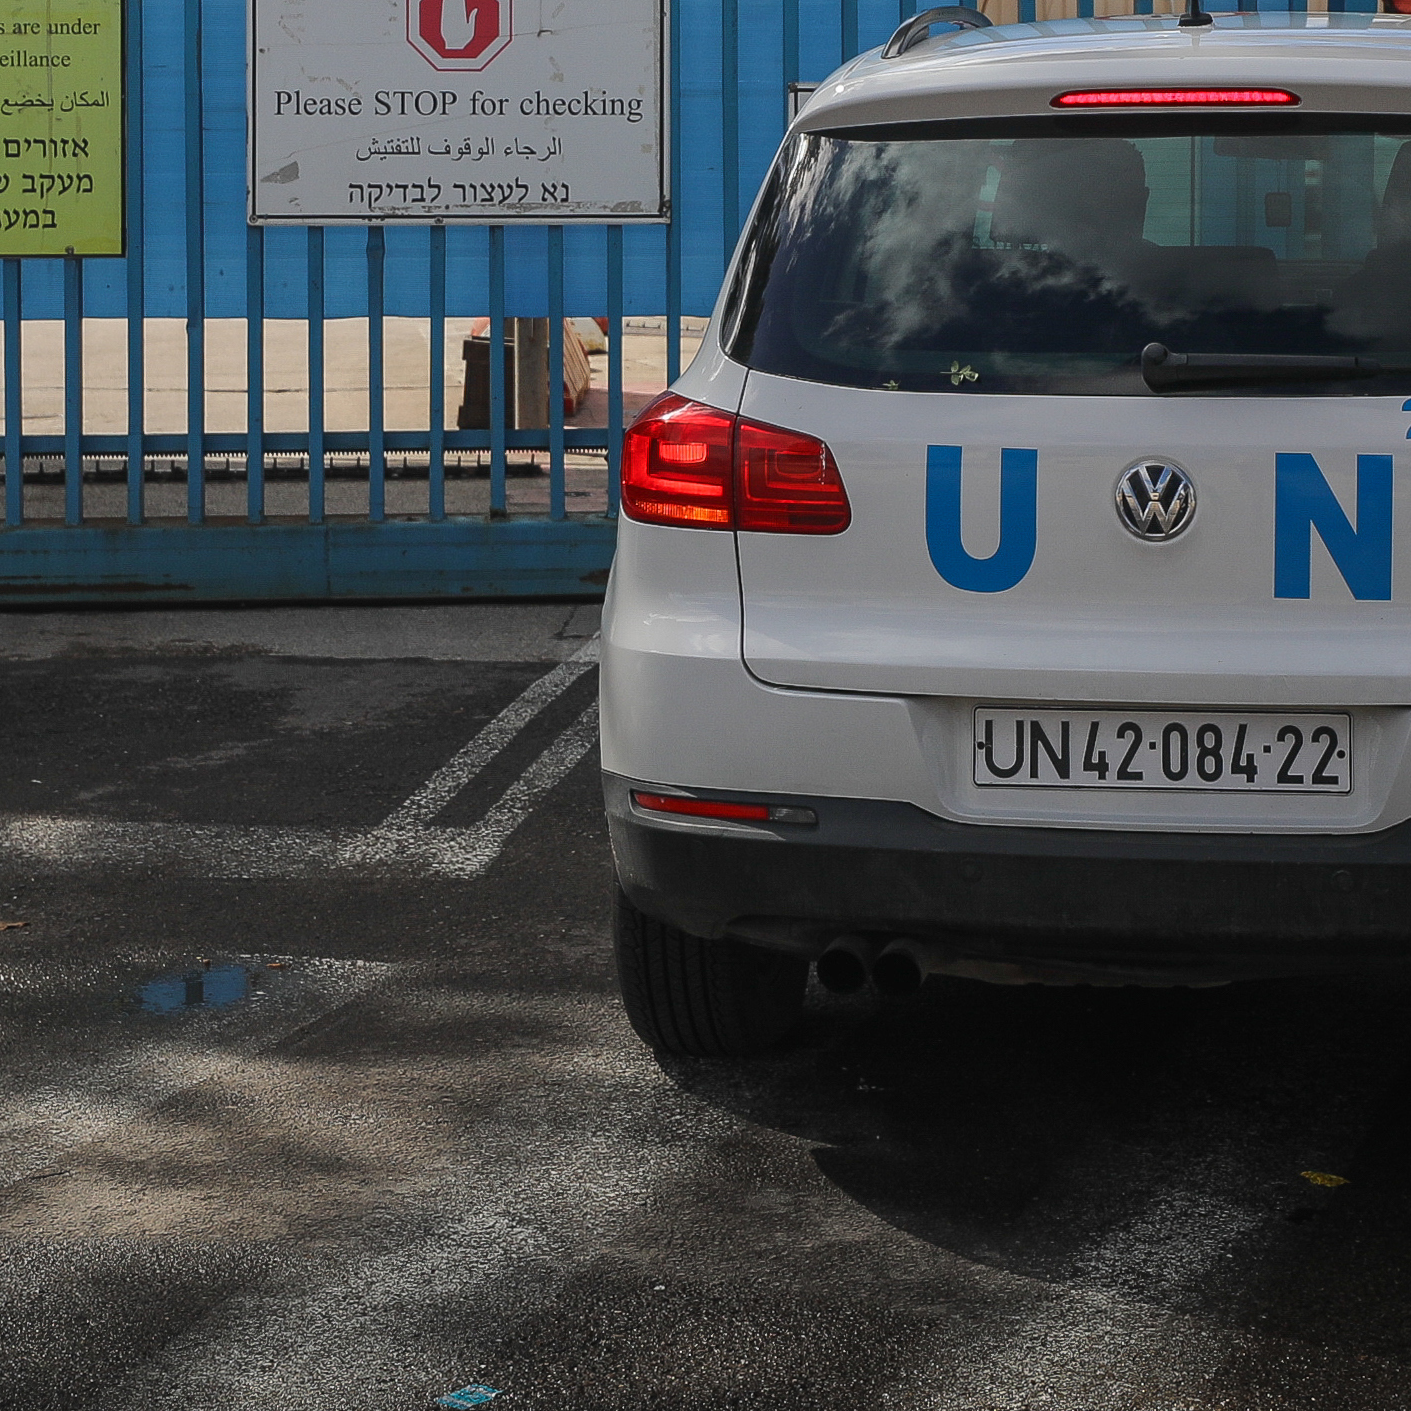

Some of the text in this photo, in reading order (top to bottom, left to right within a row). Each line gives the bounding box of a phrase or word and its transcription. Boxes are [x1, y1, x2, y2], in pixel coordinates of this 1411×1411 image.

[13, 23, 40, 34] are
[47, 18, 100, 34] under
[1, 94, 54, 115] يخضع
[61, 91, 109, 112] المكان
[275, 90, 642, 122] Please STOP for checking
[3, 138, 88, 158] אזורים
[356, 137, 561, 161] الرجاء الوقوف للتفتيش
[22, 173, 92, 199] מעקב
[349, 177, 568, 205] נא לעצור לבדיקה
[926, 445, 1393, 600] U N
